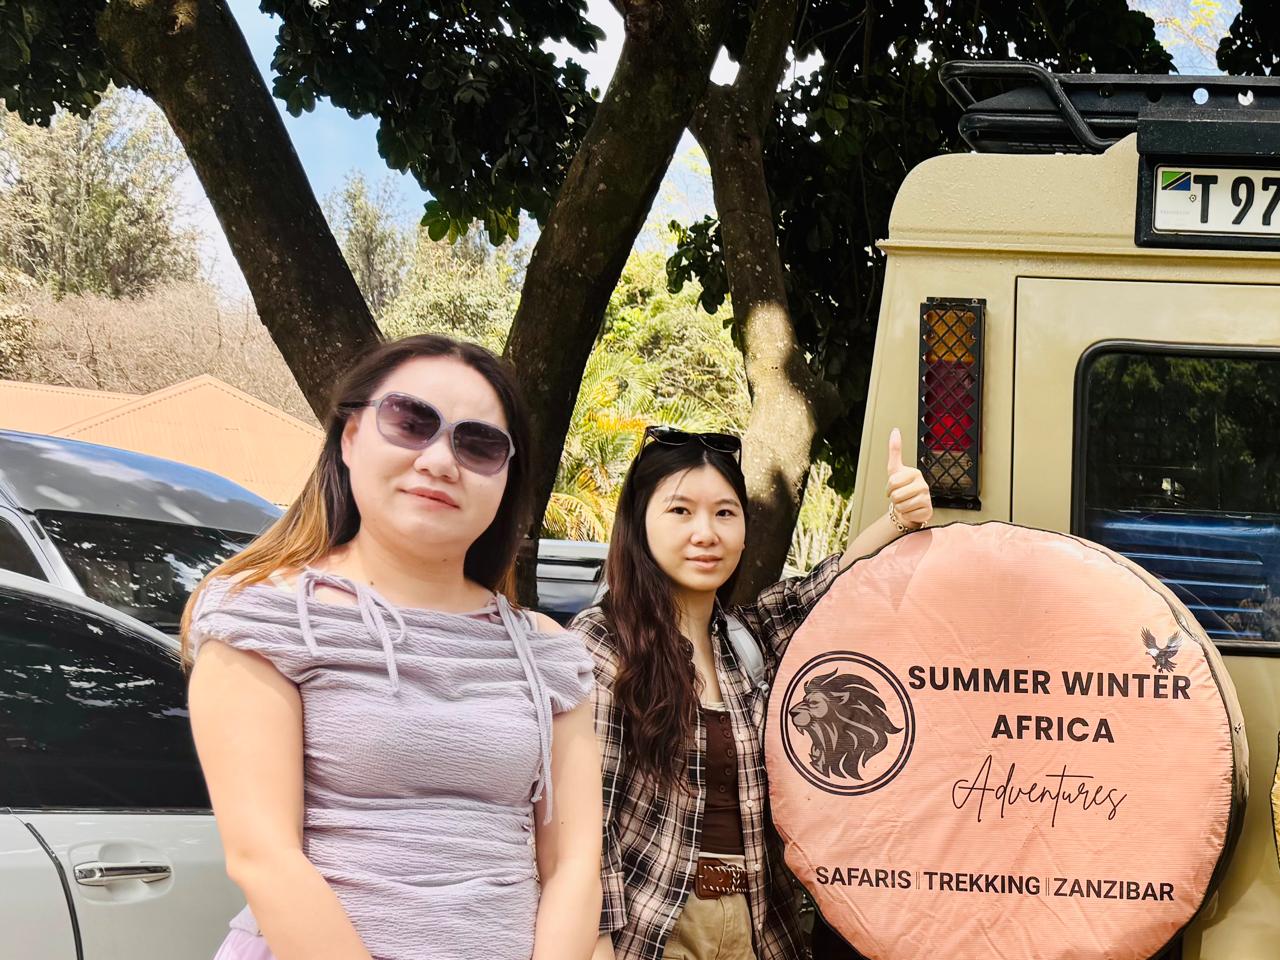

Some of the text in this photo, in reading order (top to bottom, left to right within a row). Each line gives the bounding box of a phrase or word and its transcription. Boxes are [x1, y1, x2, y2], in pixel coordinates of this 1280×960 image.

[1193, 174, 1218, 224] T
[908, 665, 1191, 700] SUMMER WINTER
[991, 715, 1115, 743] AFRICA
[952, 755, 1127, 827] Adventures
[815, 866, 1175, 901] SAFARIS TREKKING ZANZIBAR
